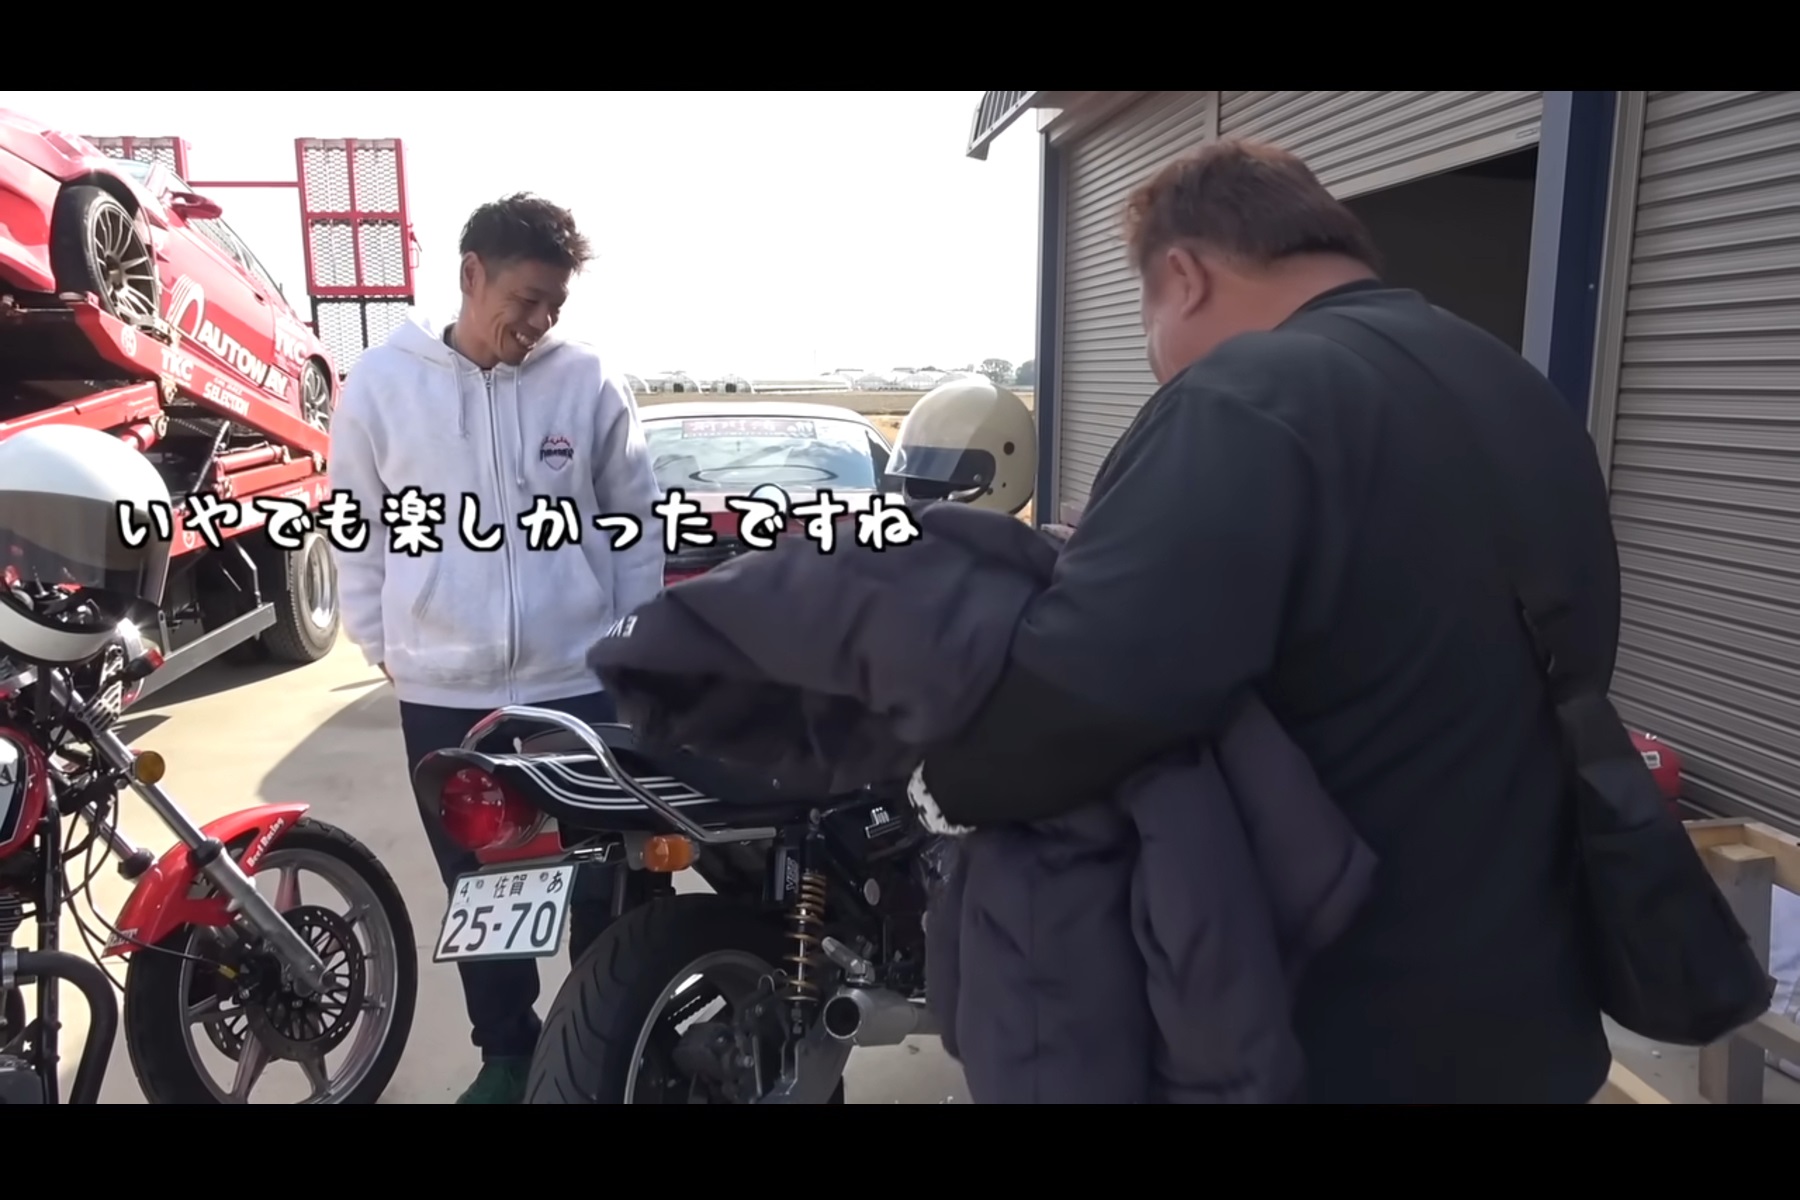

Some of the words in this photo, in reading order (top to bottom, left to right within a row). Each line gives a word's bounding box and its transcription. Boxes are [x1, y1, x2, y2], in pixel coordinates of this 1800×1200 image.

[161, 348, 194, 381] TKC
[197, 320, 288, 395] AUTOWAY
[493, 874, 527, 898] 佐賀
[546, 871, 563, 894] あ
[441, 901, 557, 954] 25-70
